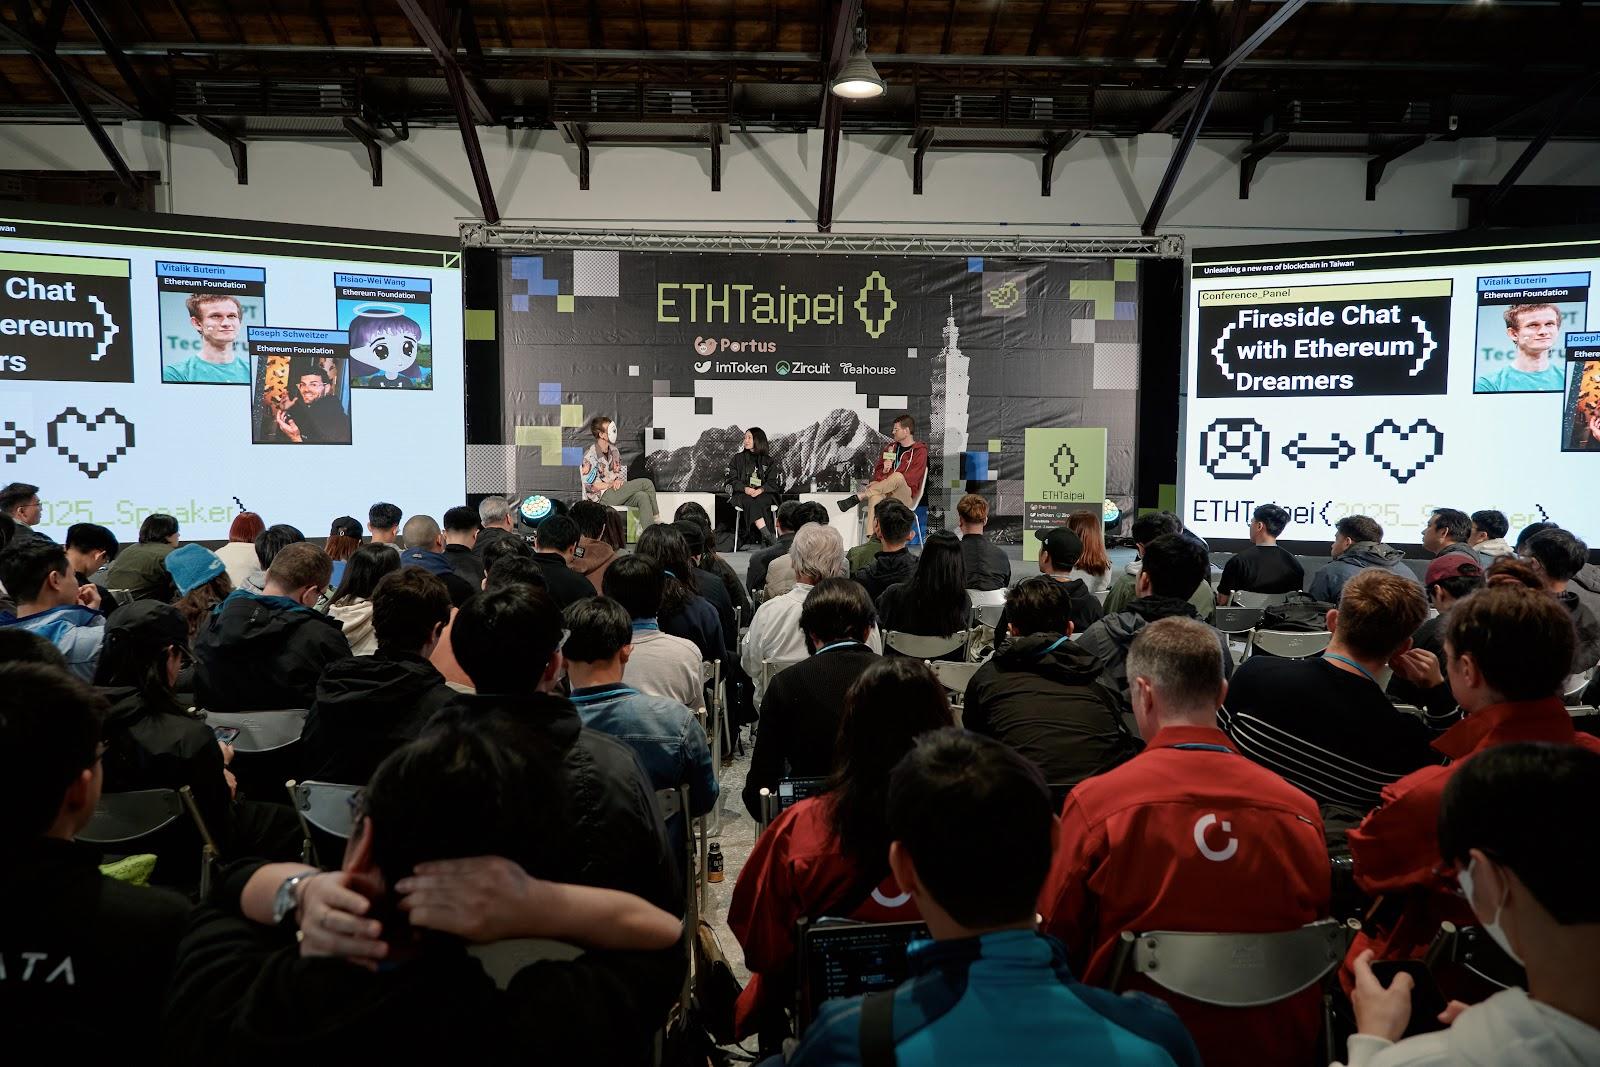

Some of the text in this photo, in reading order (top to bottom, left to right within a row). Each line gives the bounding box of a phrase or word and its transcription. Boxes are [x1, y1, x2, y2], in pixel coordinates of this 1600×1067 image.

[162, 264, 225, 274] Vitalik Buterin
[1204, 266, 1241, 274] Unleashing
[1283, 261, 1320, 270] blockchain
[164, 278, 247, 289] Ethereum Foundation
[340, 275, 406, 287] Hsiao-Wei Wang
[1483, 276, 1547, 286] Vitalik Buterin
[5, 277, 76, 301] Chat
[342, 289, 415, 299] Ethereum Foundation
[1202, 289, 1291, 300] Conference_Panel
[1483, 289, 1568, 299] Ethereum Foundation
[657, 283, 844, 333] ETHTaipei
[1238, 304, 1401, 329] Fireside Chat
[249, 329, 328, 339] Joseph Schweitzer
[256, 345, 334, 355] Ethereum Foundation
[720, 338, 776, 353] Portus
[1237, 338, 1414, 360] with Ethereum
[716, 362, 768, 374] imToken
[791, 362, 831, 374] Zircuit
[840, 362, 896, 375] Teahouse
[1236, 372, 1354, 391] Dreamers
[1042, 490, 1085, 501] ETHTaipei
